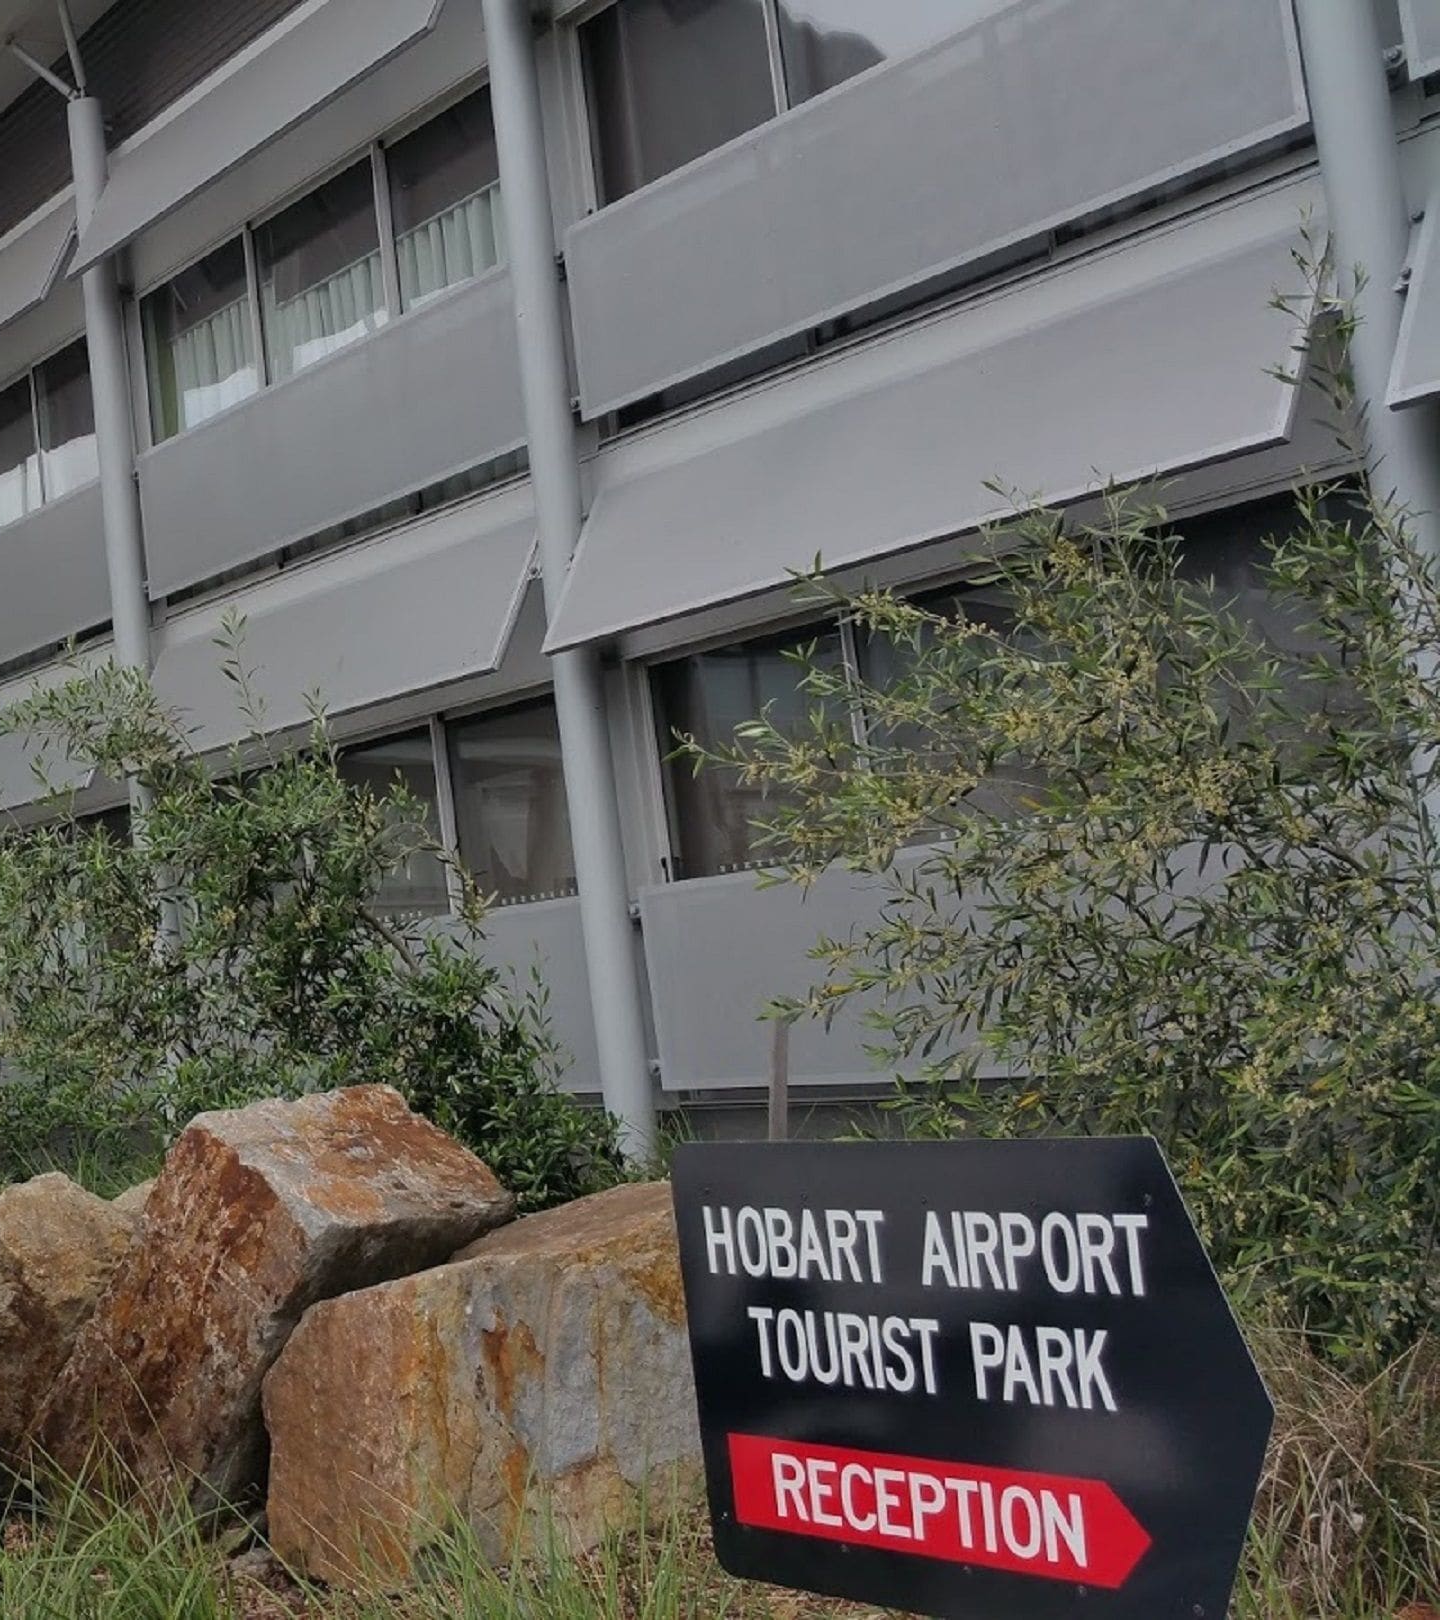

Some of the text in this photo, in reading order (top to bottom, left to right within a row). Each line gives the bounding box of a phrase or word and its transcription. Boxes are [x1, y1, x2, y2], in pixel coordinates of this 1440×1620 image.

[702, 1204, 1148, 1297] HOBART AIRPORT
[747, 1306, 1119, 1412] TOURIST PARK
[771, 1453, 1088, 1568] RECEPTION
